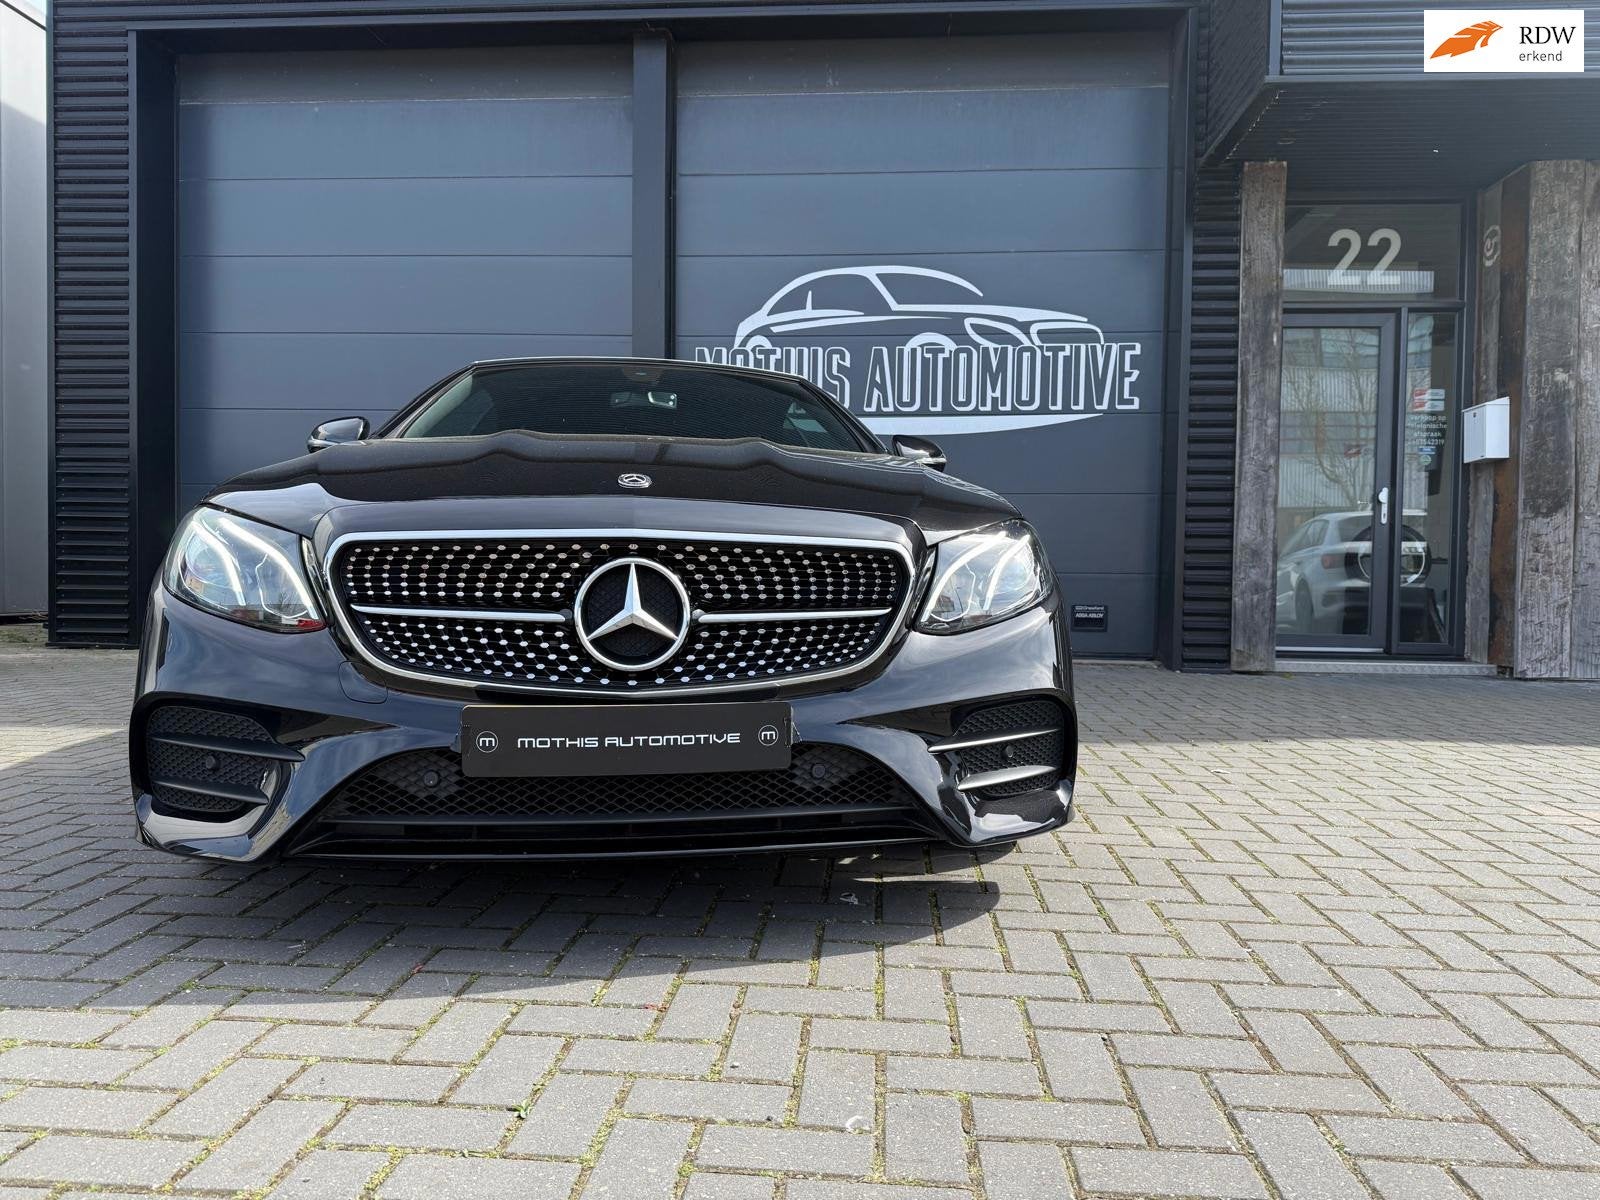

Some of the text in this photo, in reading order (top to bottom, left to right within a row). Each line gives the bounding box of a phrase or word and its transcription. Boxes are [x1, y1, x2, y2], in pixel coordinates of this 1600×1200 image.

[1327, 228, 1401, 285] 22
[863, 343, 1141, 412] AUTOMOTIVE
[517, 733, 740, 748] MOTHIS AUTOMOTIVE
